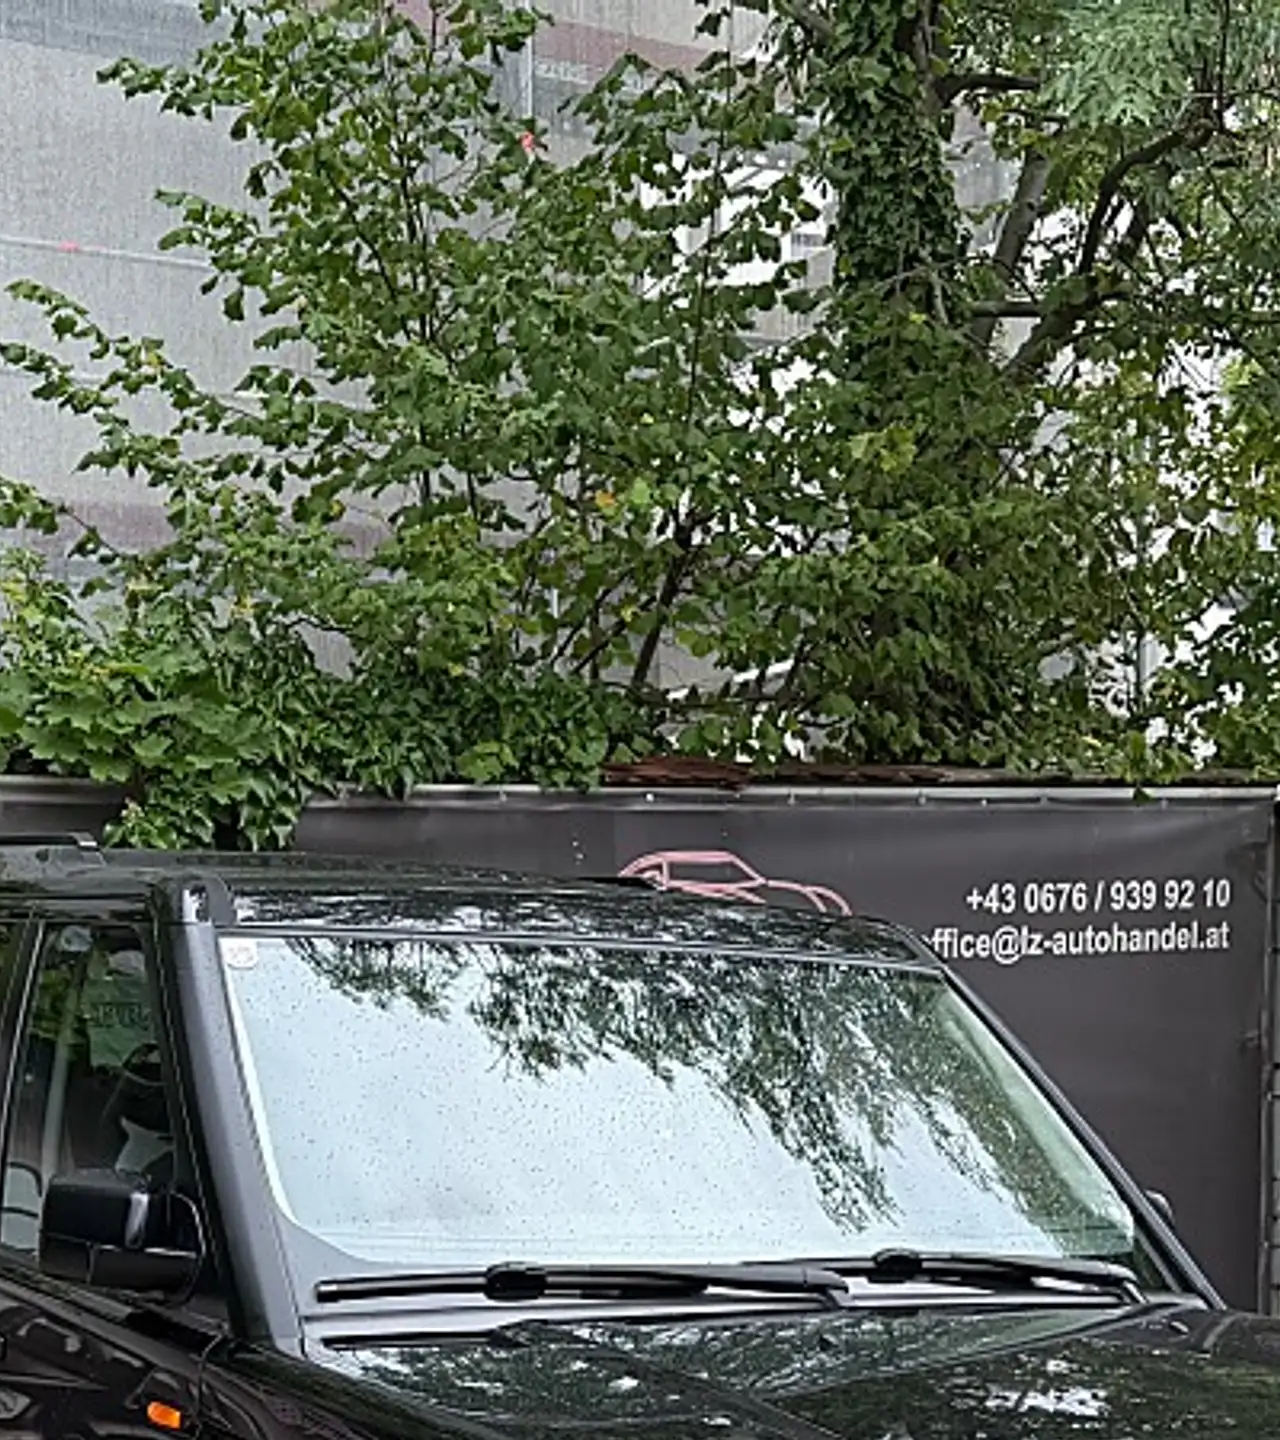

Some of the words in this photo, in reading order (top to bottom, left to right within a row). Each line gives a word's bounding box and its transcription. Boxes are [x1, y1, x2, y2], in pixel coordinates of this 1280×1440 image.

[966, 882, 1016, 914] +43
[1023, 881, 1087, 914] 0676
[1093, 880, 1105, 911] /
[1110, 880, 1157, 911] 939
[1164, 879, 1195, 909] 92
[1202, 879, 1231, 908] 10
